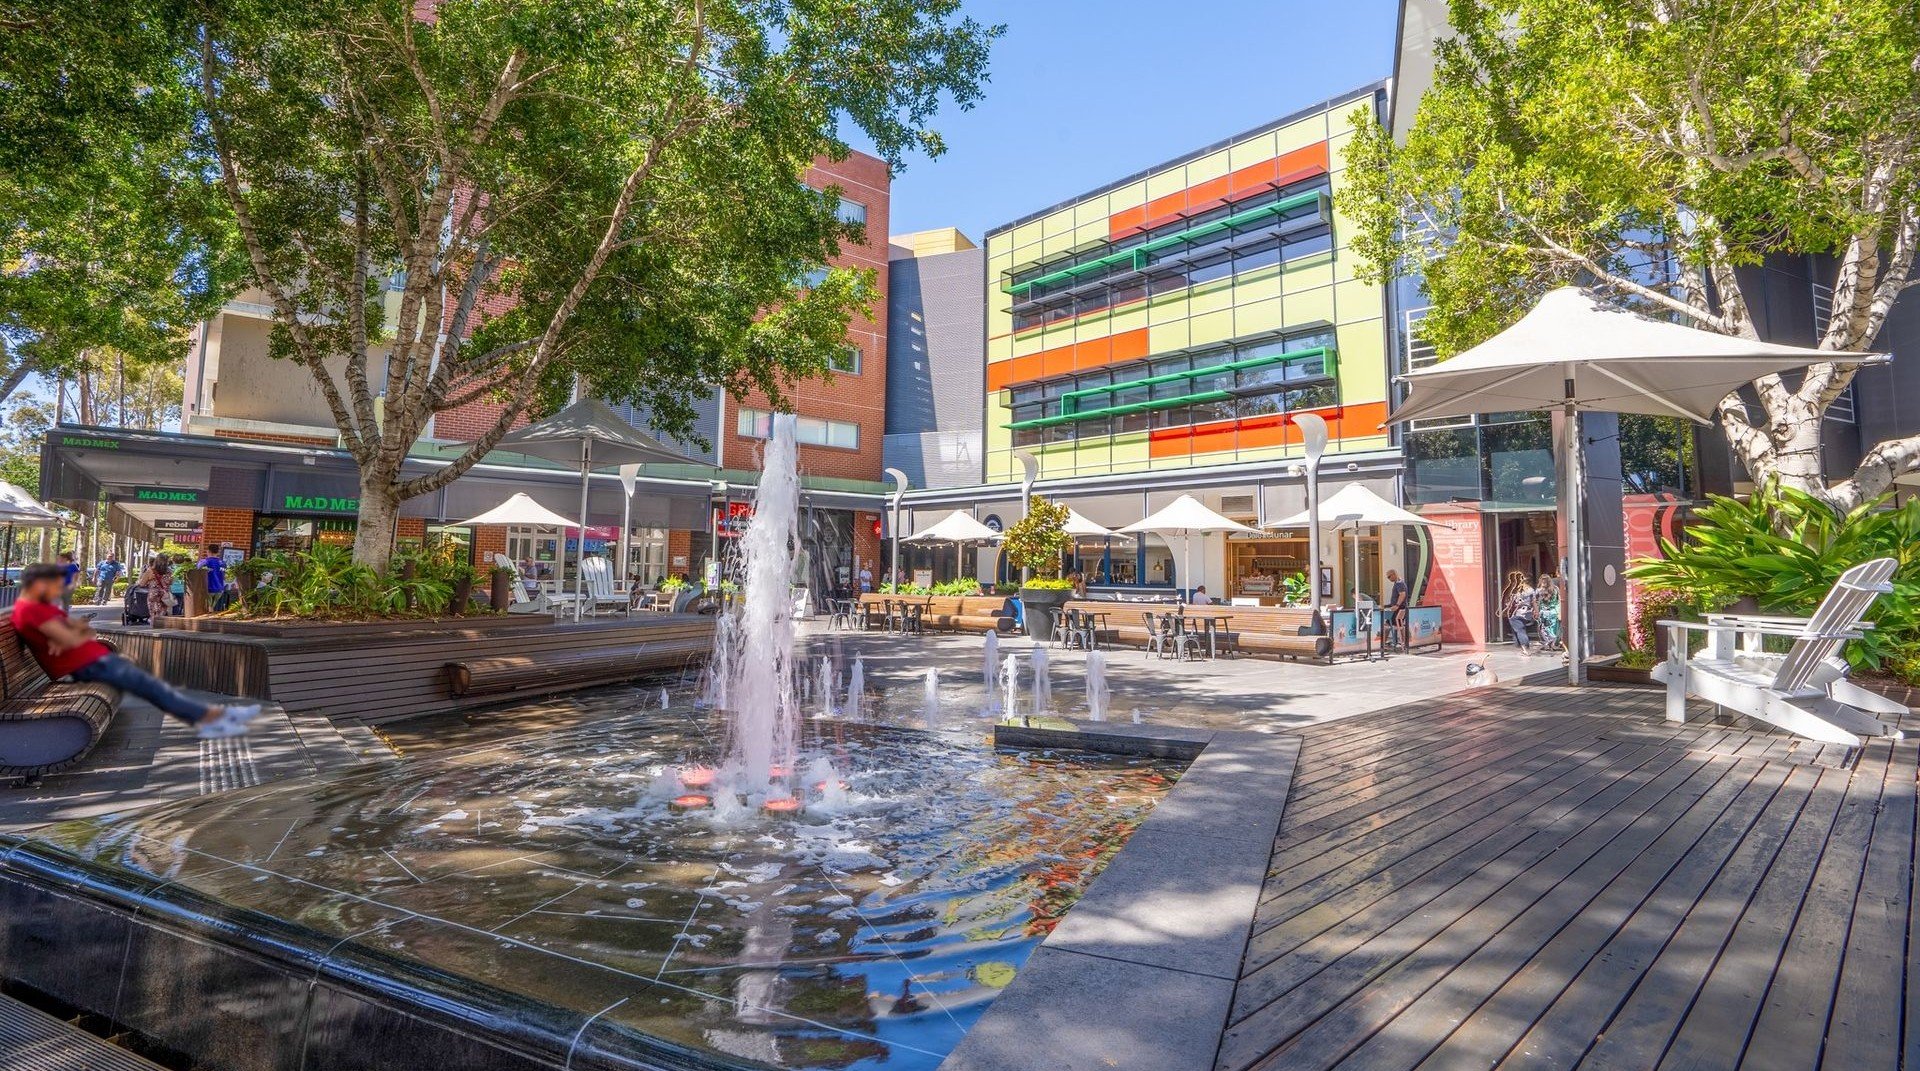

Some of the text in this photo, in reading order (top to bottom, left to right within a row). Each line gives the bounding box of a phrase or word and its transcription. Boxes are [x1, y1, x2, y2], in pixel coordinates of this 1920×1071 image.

[63, 437, 120, 449] MAD MEX
[138, 490, 197, 501] MAD MEX
[285, 496, 360, 511] MAD ME
